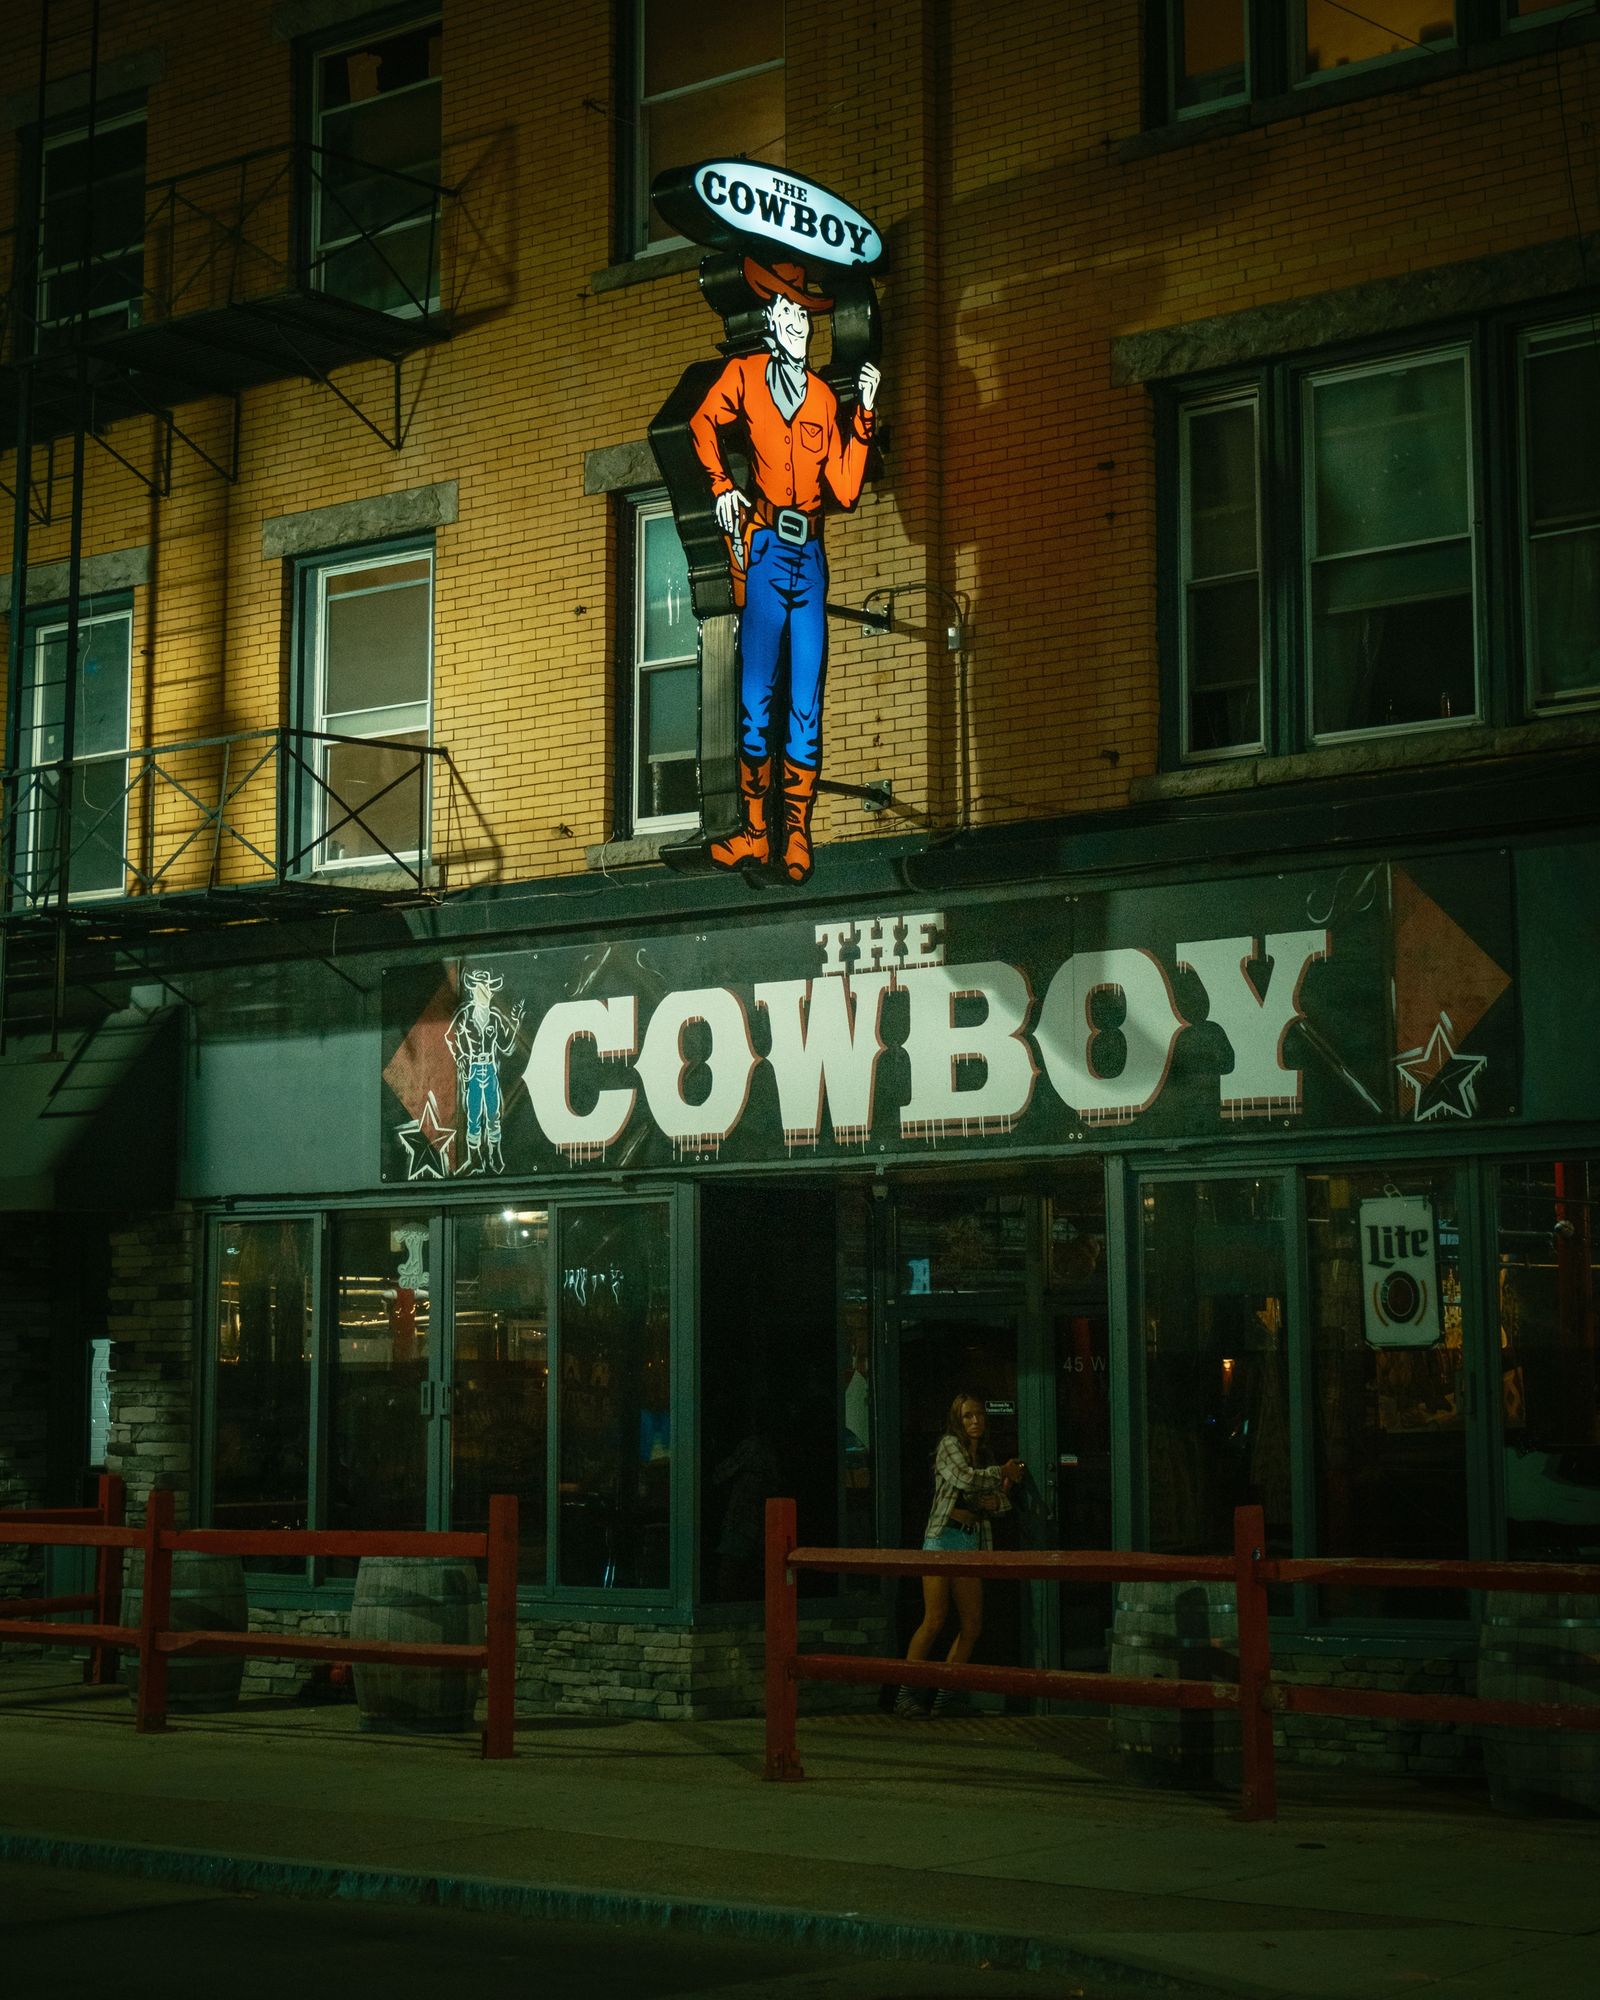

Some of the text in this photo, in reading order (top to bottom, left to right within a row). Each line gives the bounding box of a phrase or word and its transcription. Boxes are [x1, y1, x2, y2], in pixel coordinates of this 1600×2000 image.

[701, 170, 872, 257] COWBOY
[772, 177, 808, 203] THE
[814, 912, 945, 975] THE
[522, 929, 1331, 1164] COWBOY
[1365, 1225, 1429, 1269] Lite
[1063, 1356, 1085, 1373] 45
